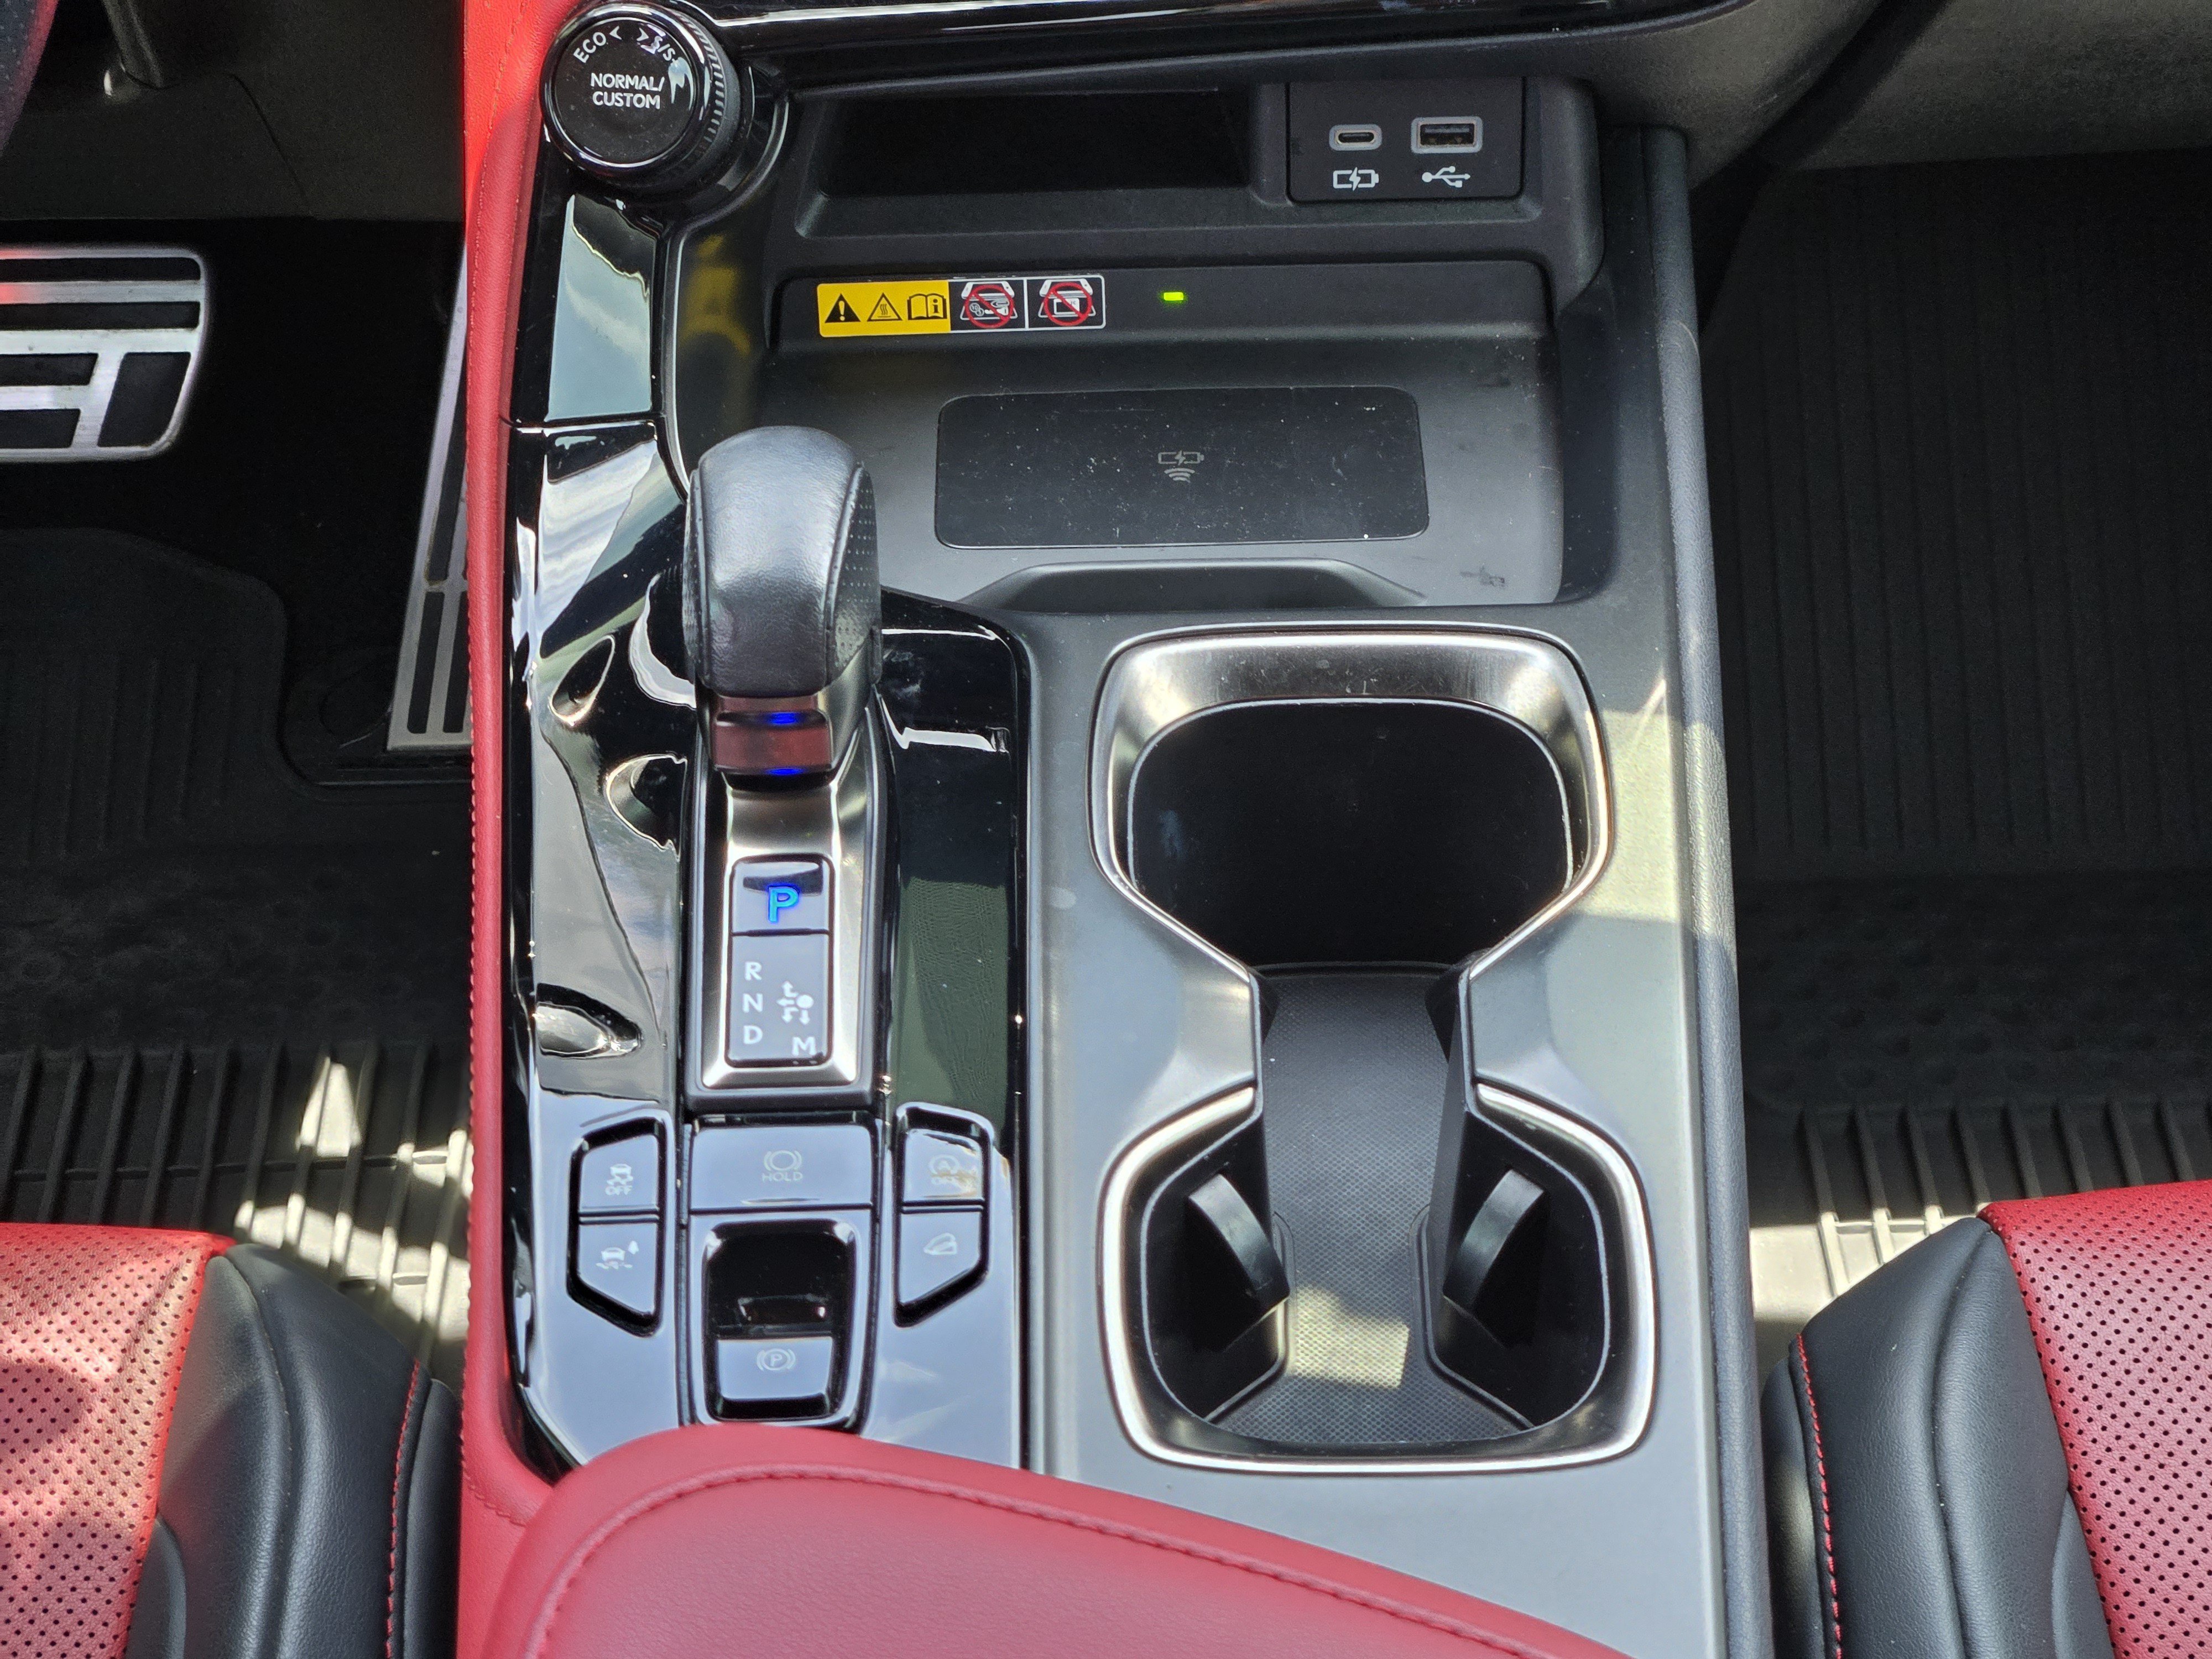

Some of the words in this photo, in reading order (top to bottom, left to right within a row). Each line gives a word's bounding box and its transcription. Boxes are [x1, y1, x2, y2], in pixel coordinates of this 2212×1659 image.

[573, 32, 607, 63] ECO
[591, 72, 665, 92] NORMAL/
[592, 91, 660, 109] CUSTOM
[768, 886, 799, 922] P
[744, 961, 762, 980] R
[742, 993, 763, 1013] N
[743, 1025, 763, 1045] D
[792, 1036, 816, 1056] M
[762, 1172, 803, 1182] HOLD
[605, 1185, 633, 1196] OFF
